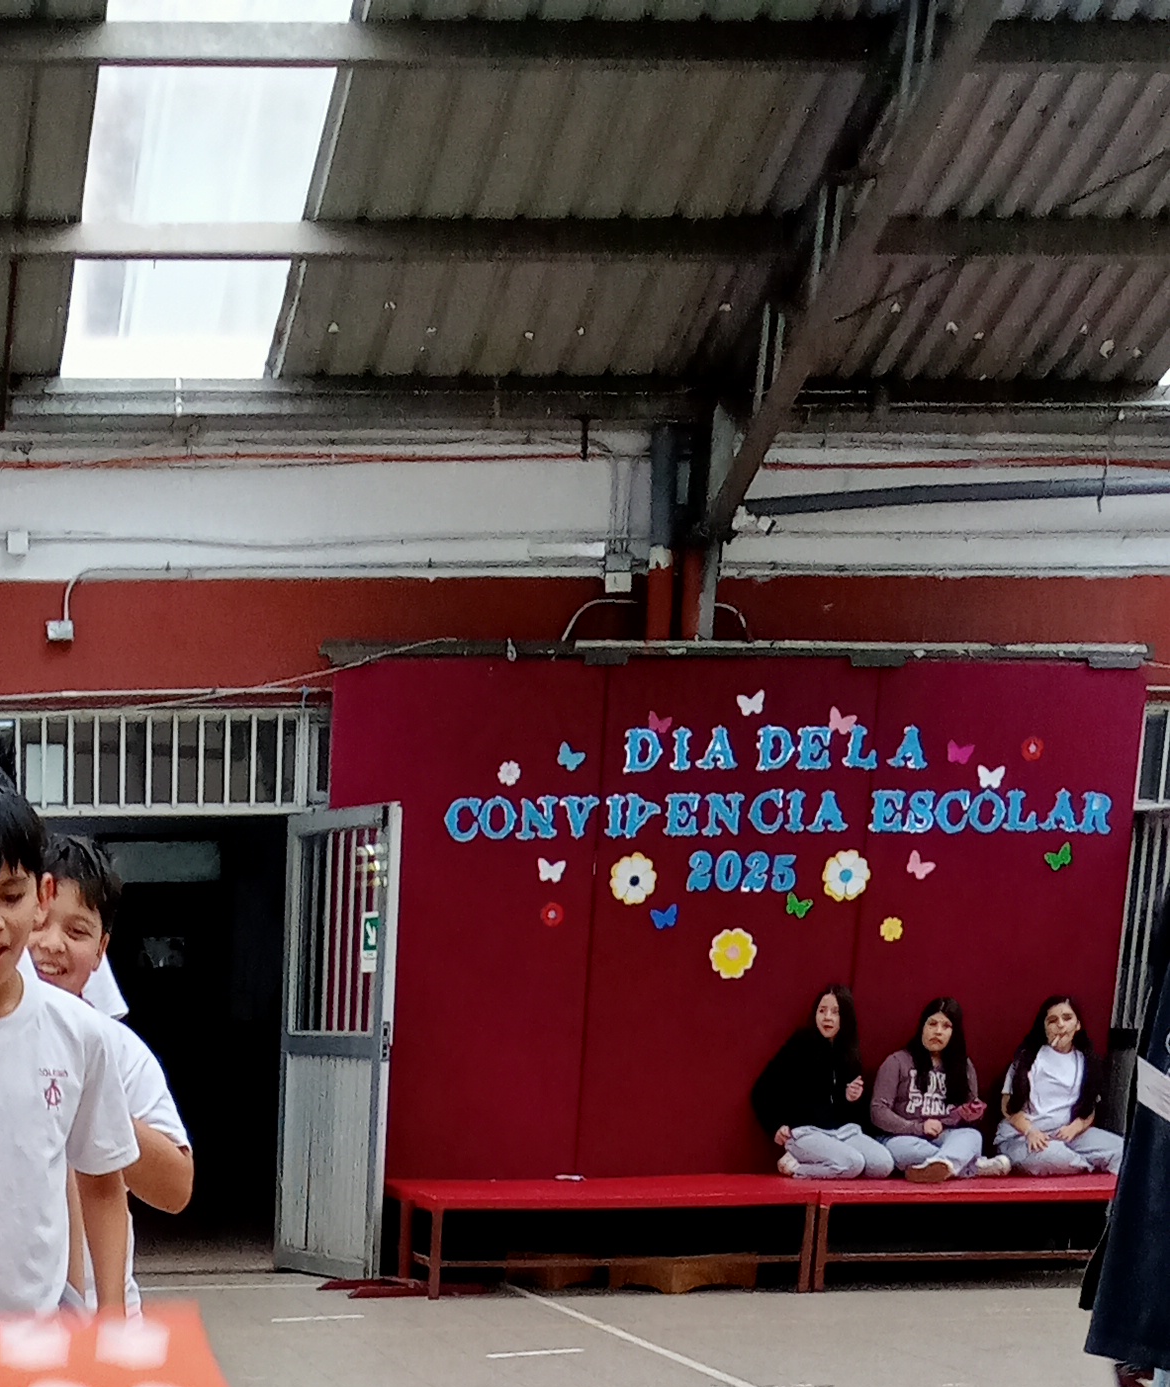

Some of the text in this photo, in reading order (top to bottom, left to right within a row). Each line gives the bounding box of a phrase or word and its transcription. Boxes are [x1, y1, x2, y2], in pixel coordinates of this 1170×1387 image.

[623, 725, 738, 774] DIA
[868, 787, 1112, 835] ESCOLAR
[686, 850, 797, 892] 2025
